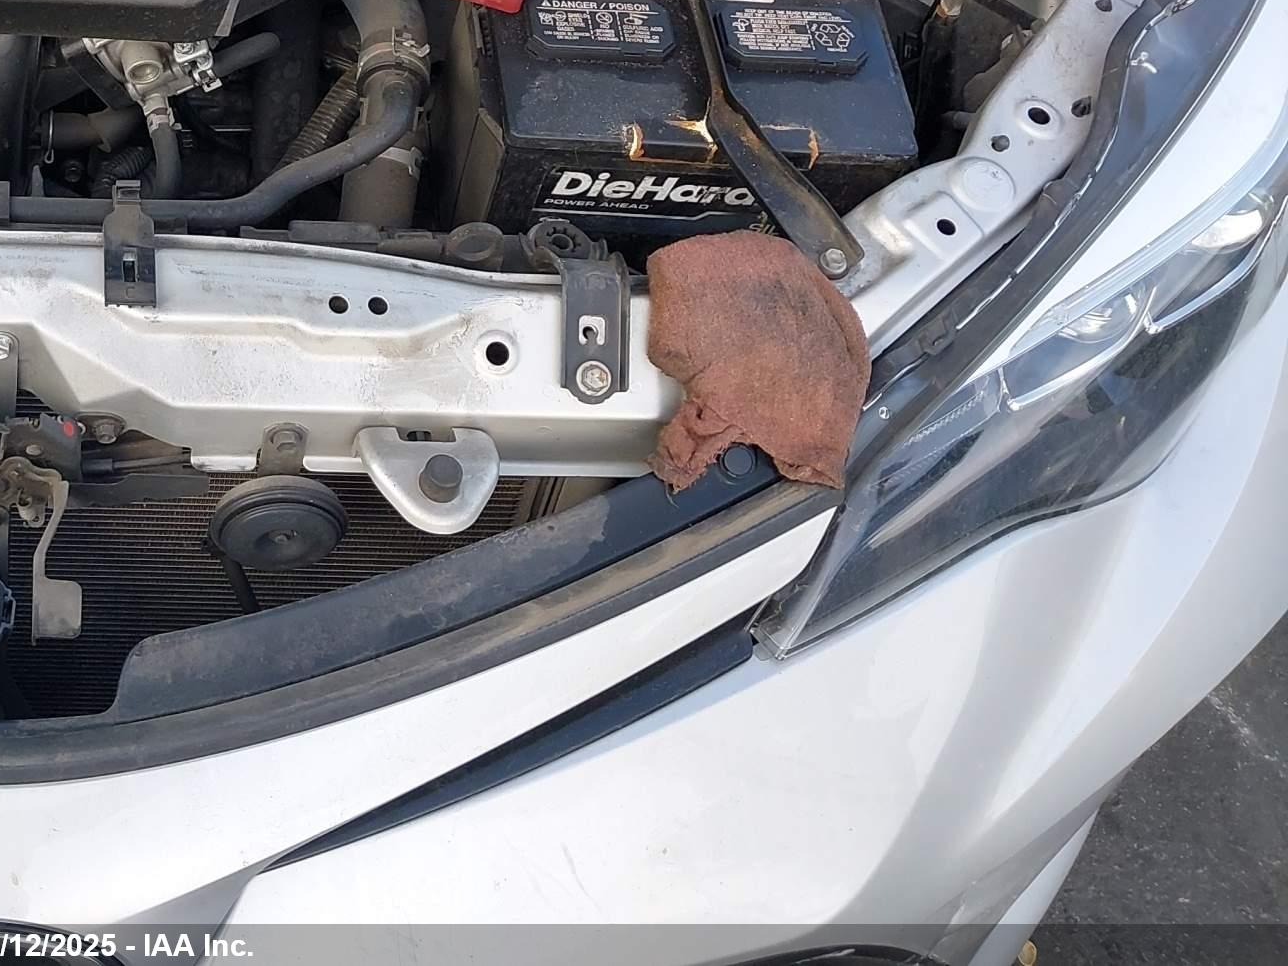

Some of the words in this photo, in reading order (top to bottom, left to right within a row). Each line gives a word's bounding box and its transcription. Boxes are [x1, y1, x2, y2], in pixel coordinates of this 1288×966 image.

[552, 0, 598, 10] DANGER
[599, 2, 607, 10] /
[609, 2, 650, 12] POISON
[543, 198, 596, 207] POWER
[599, 201, 651, 210] AHEAD
